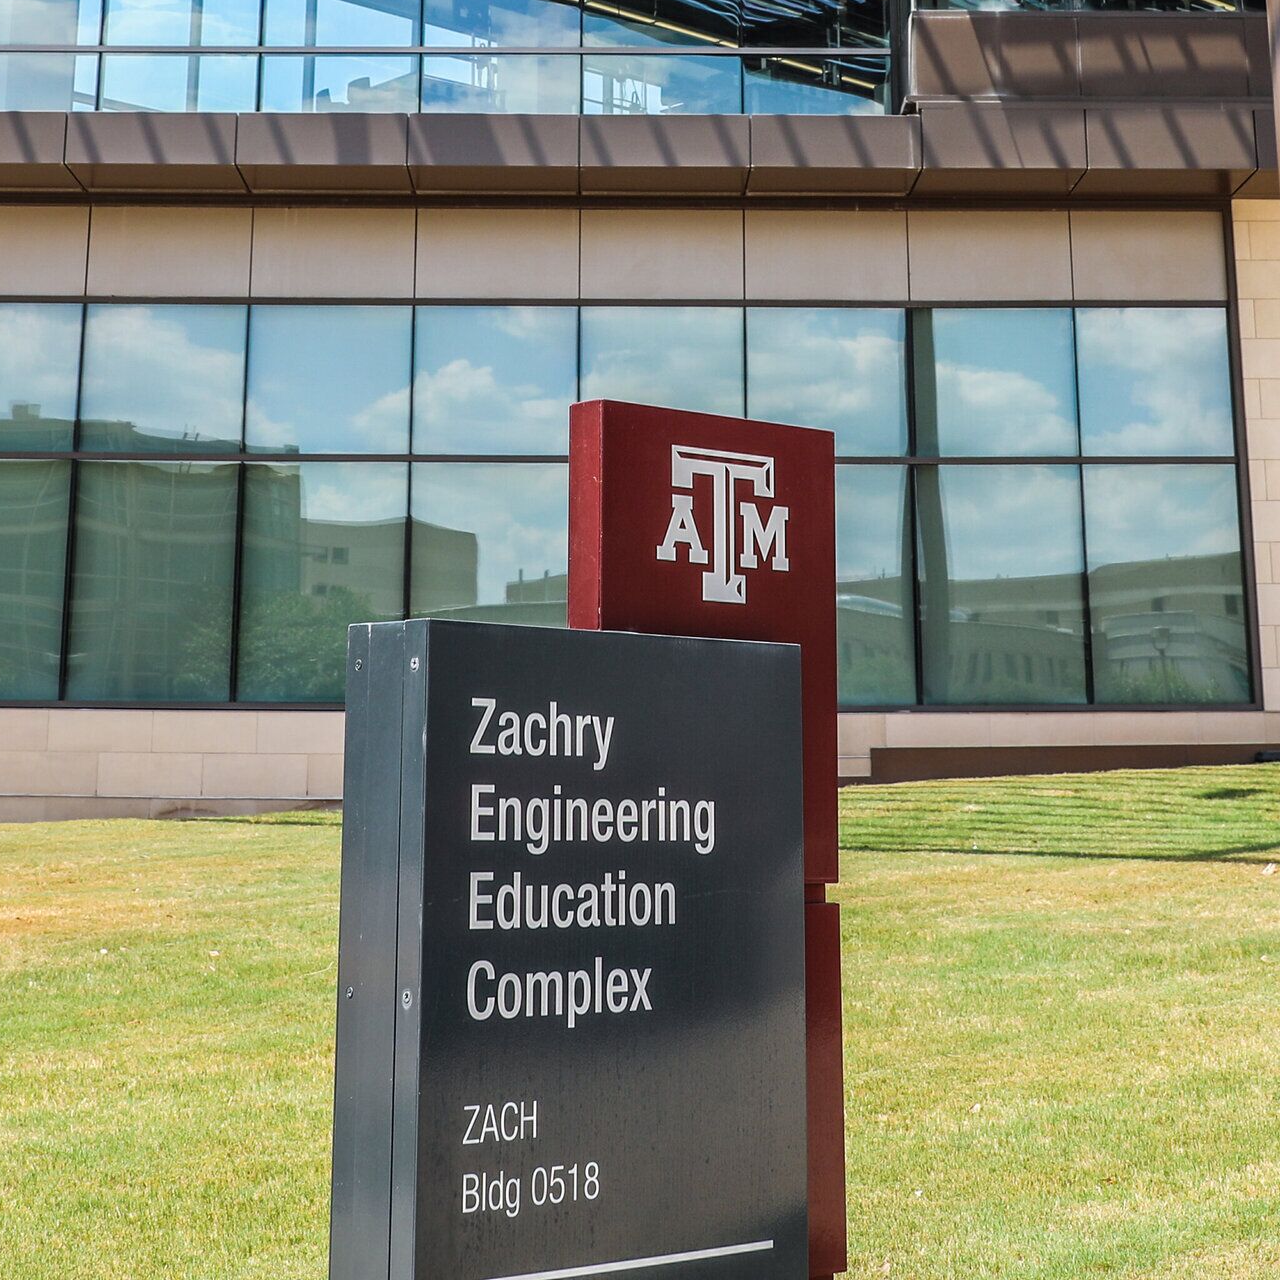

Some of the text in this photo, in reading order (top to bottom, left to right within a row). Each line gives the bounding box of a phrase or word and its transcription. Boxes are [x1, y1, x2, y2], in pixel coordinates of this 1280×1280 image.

[469, 697, 615, 771] Zachry
[470, 784, 716, 855] Engineering
[469, 870, 676, 930] Education
[466, 956, 653, 1029] Complex
[462, 1100, 538, 1145] ZACH
[462, 1161, 600, 1218] Bldg 0518
